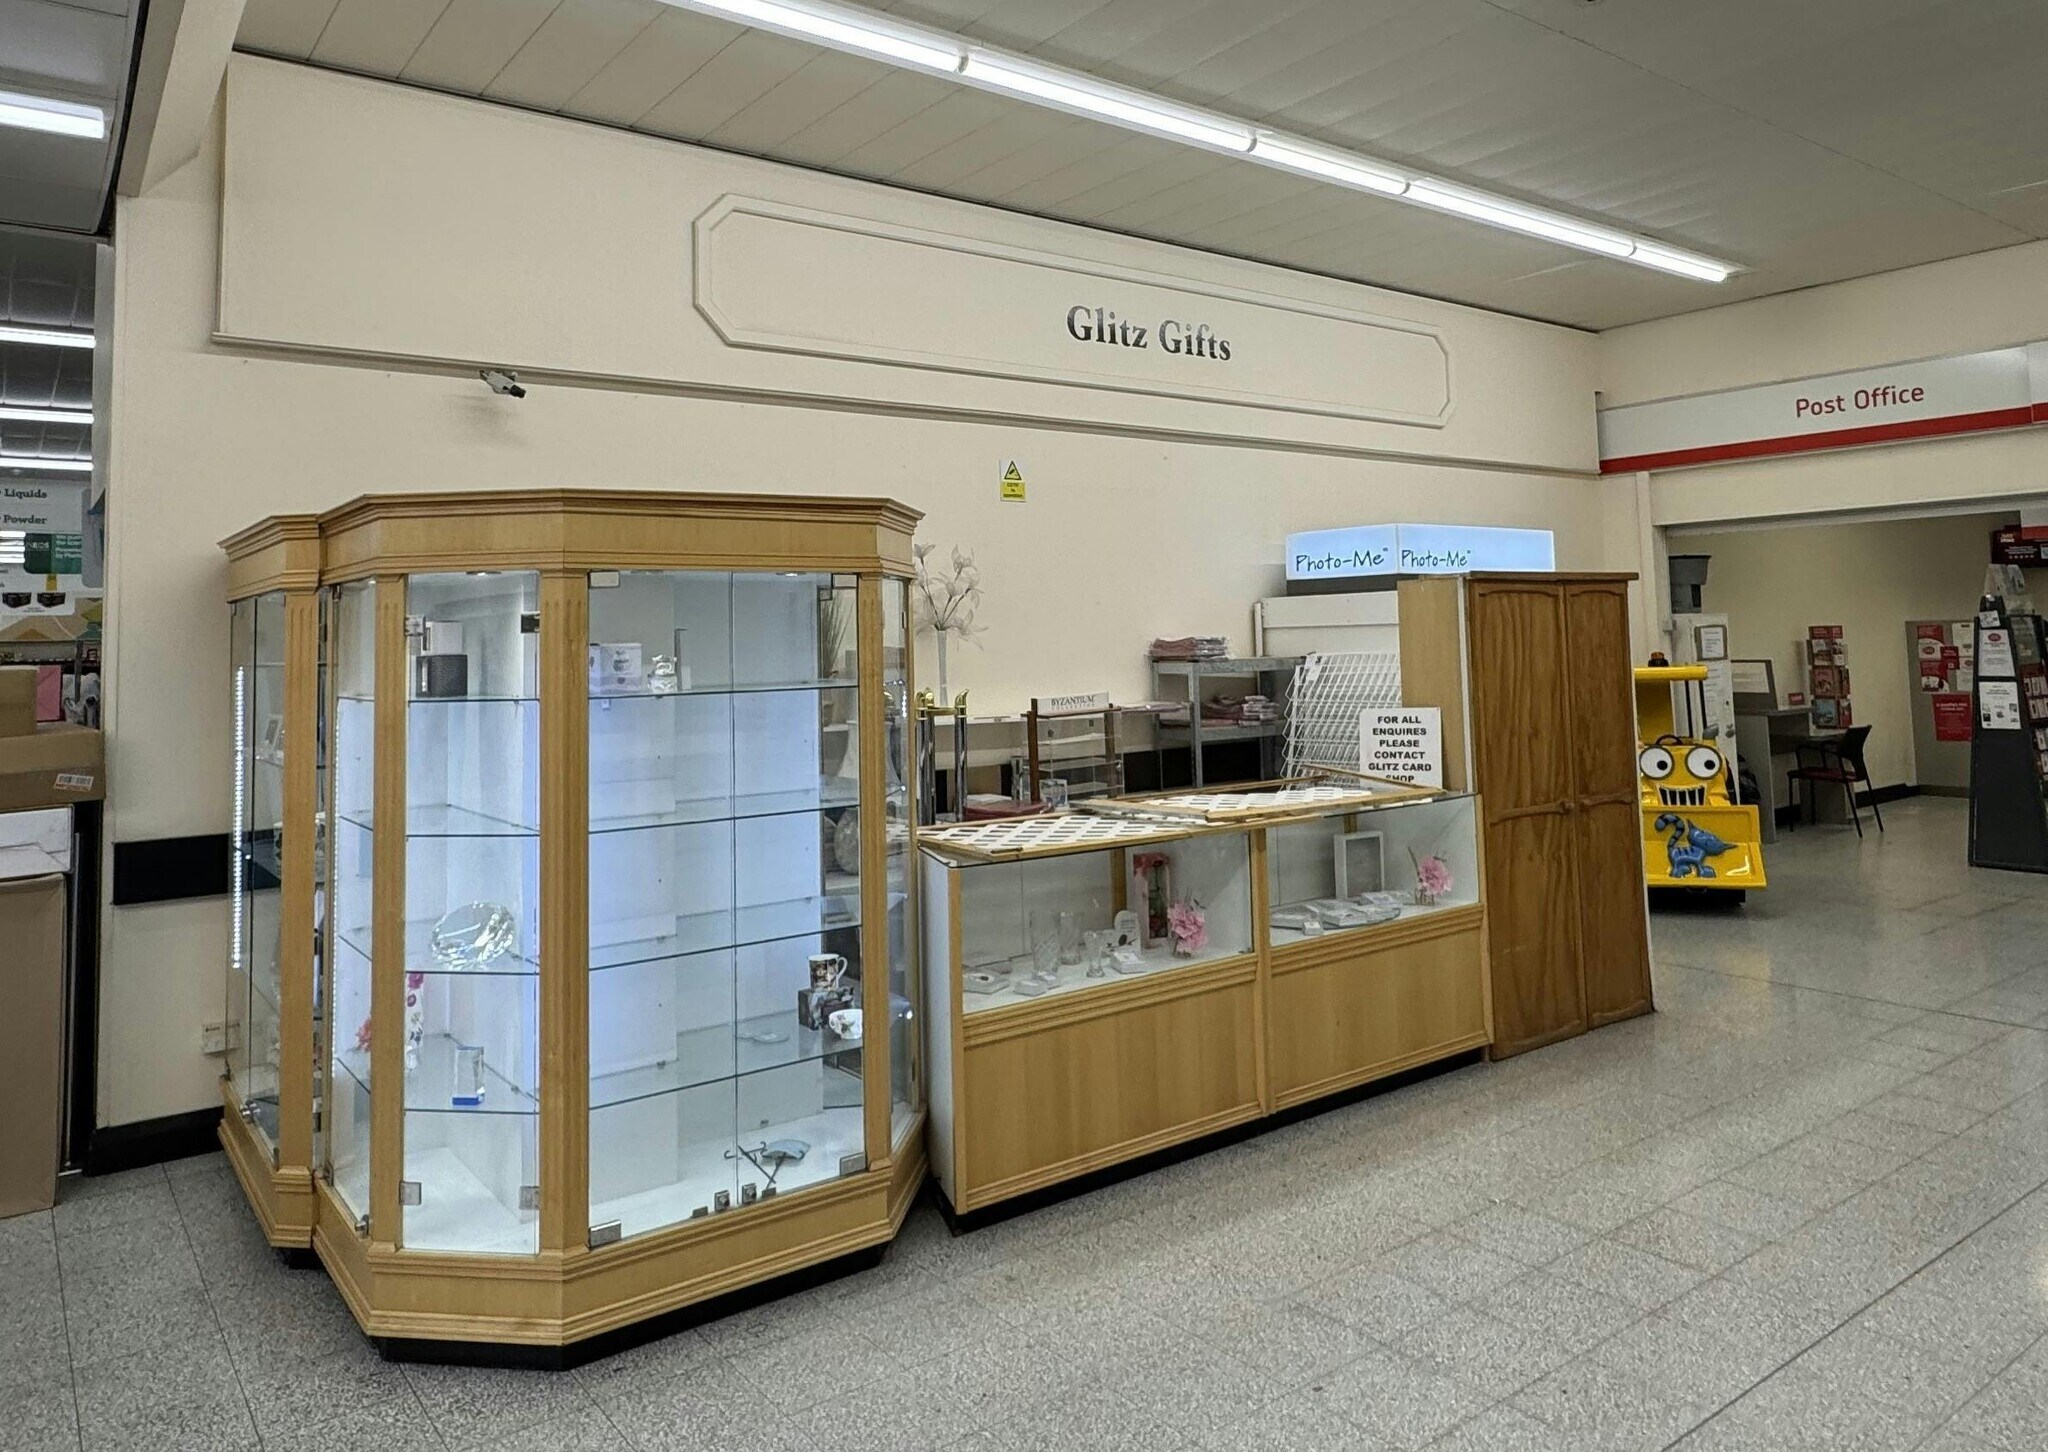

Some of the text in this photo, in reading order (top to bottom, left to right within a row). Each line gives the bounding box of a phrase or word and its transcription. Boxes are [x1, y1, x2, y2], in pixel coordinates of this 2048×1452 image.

[1066, 304, 1232, 361] Glitz Gifts
[1795, 385, 1924, 418] Post Office
[4, 488, 48, 500] Liquids
[3, 514, 48, 524] Powder
[1051, 696, 1095, 706] BYZANTIUM
[1377, 716, 1422, 724] FOR ALL
[1372, 727, 1427, 736] ENQUIRES
[1379, 739, 1420, 748] PLEASE
[1374, 751, 1426, 760] CONTACT
[1368, 763, 1432, 772] GLITZ CARD
